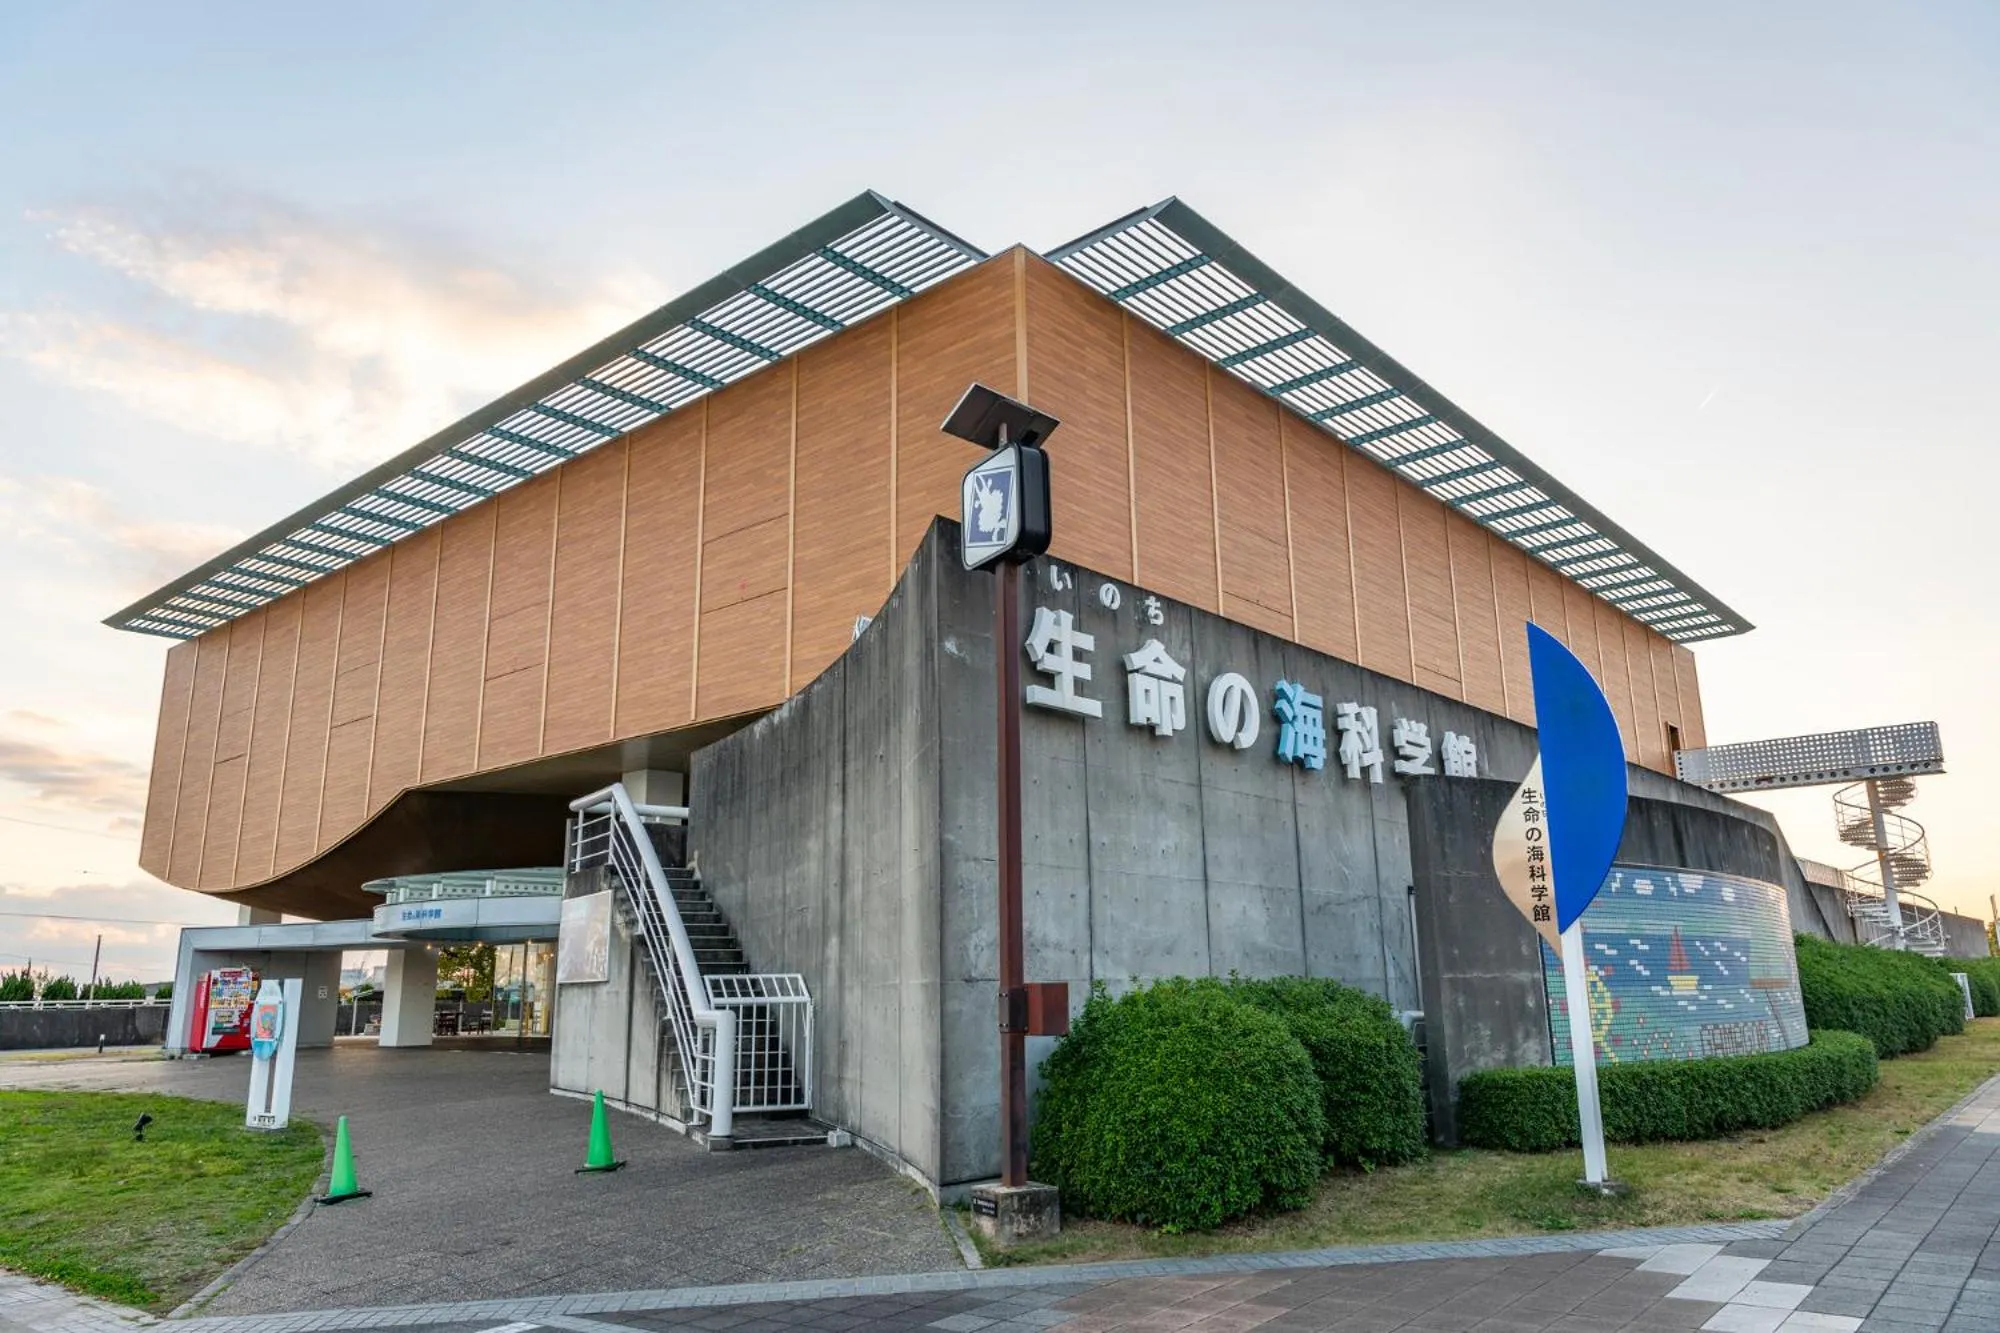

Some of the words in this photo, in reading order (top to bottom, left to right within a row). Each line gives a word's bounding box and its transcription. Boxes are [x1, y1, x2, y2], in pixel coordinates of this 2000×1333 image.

[1050, 564, 1164, 626] いのち
[1024, 606, 1478, 784] 生命の海科学館
[1520, 787, 1551, 923] 生命の海科学館
